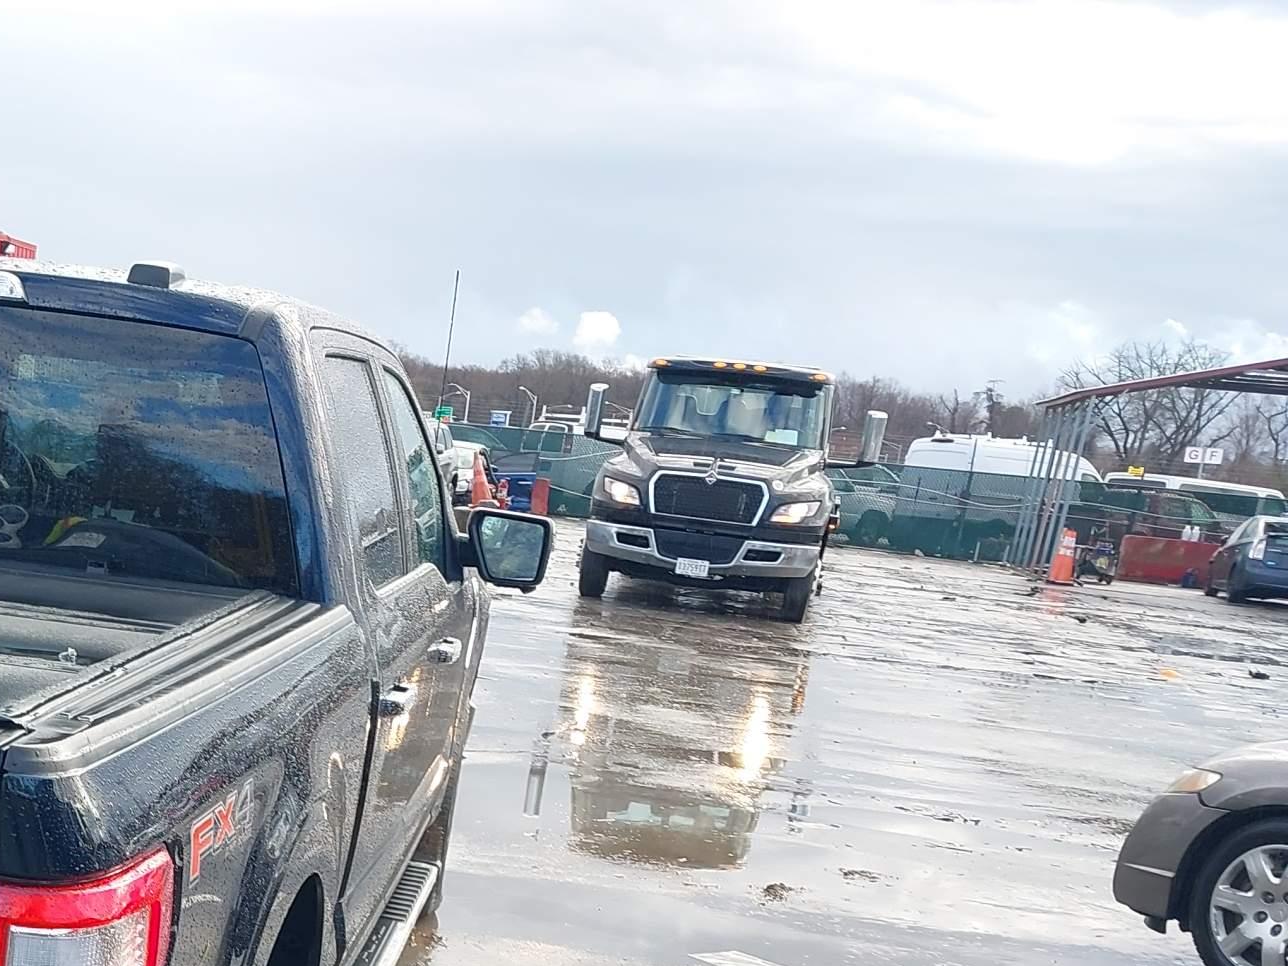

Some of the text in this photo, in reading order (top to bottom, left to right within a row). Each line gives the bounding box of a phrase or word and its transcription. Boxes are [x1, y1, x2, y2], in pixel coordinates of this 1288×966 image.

[1189, 449, 1199, 460] G
[1210, 451, 1218, 460] F
[189, 778, 254, 887] FX4
